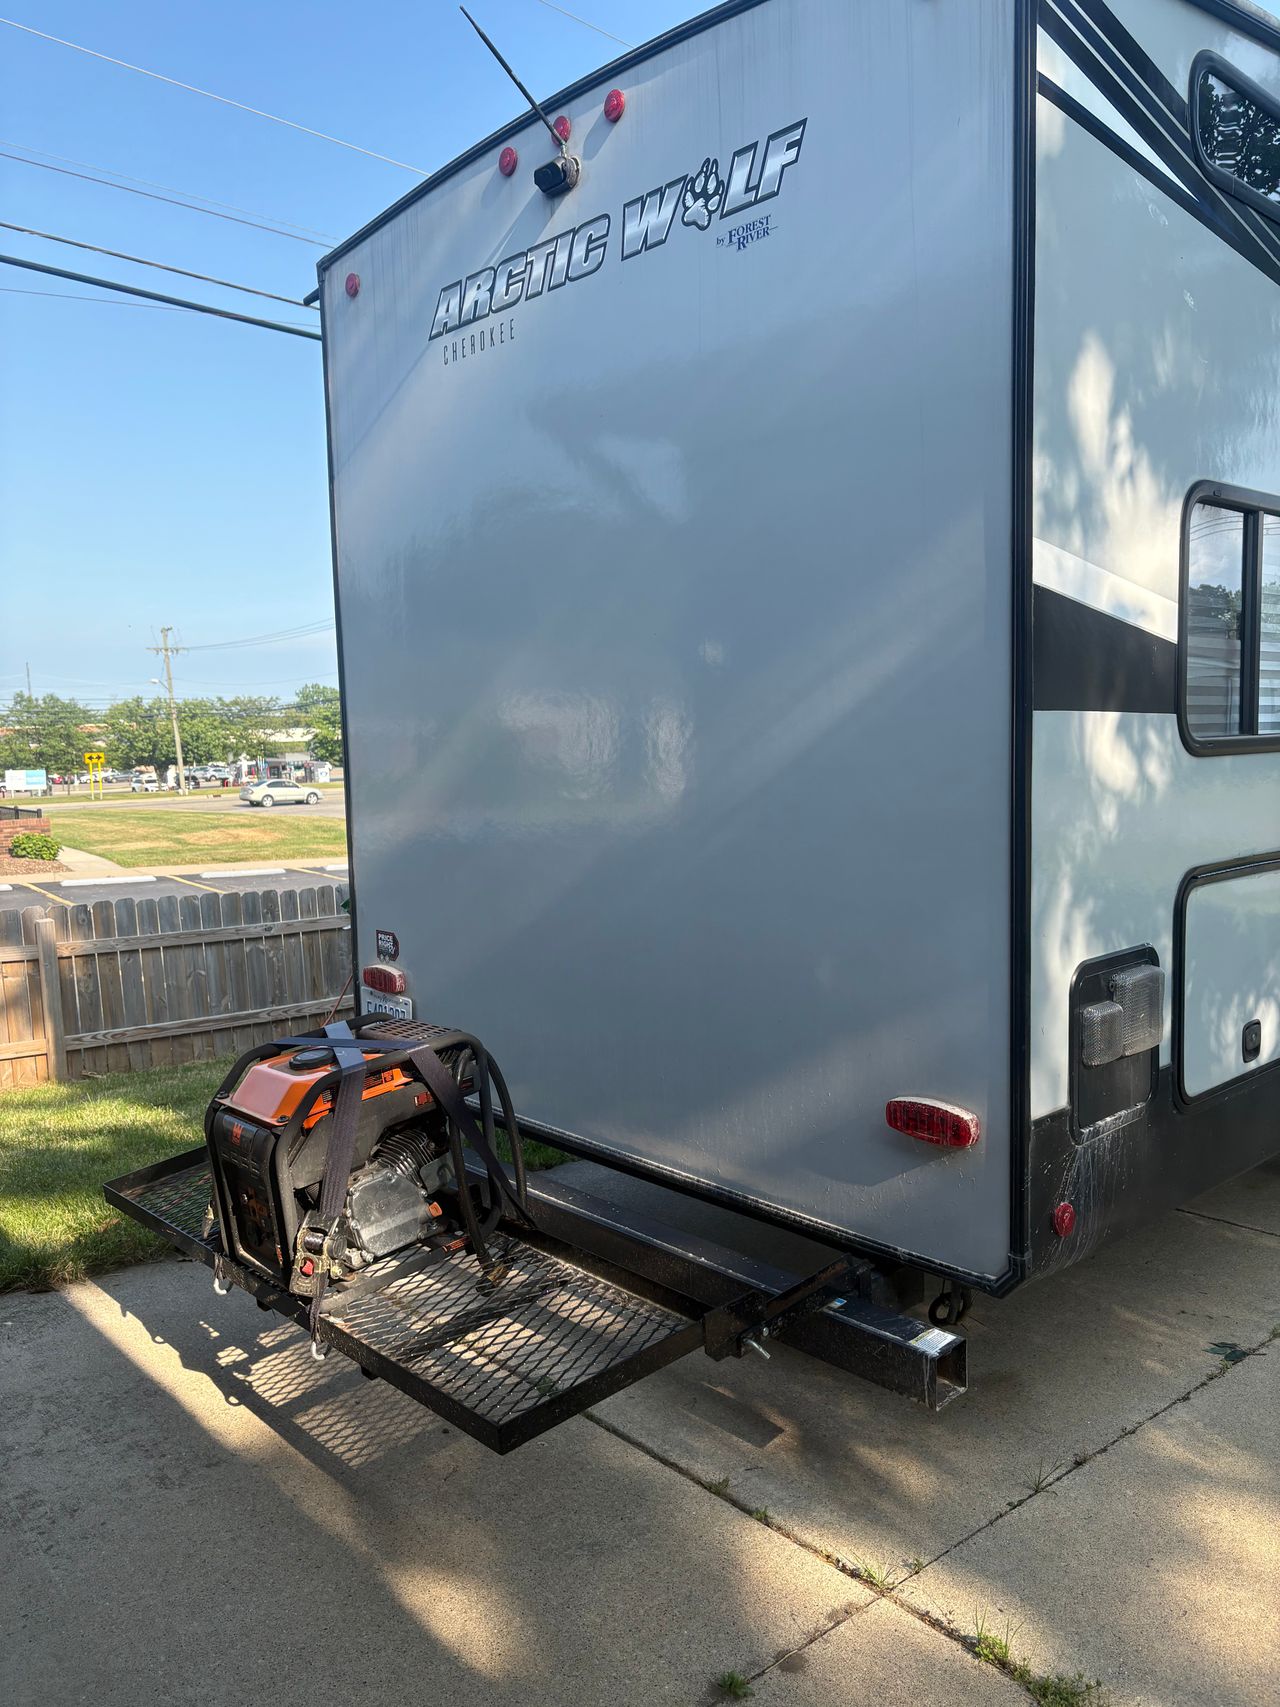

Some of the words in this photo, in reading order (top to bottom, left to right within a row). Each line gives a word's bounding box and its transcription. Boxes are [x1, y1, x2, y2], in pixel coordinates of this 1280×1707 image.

[716, 237, 725, 246] by
[728, 214, 771, 244] FOREST
[736, 226, 770, 251] RIVER
[428, 213, 611, 341] ARCTIC
[443, 318, 515, 366] CHEROKEE
